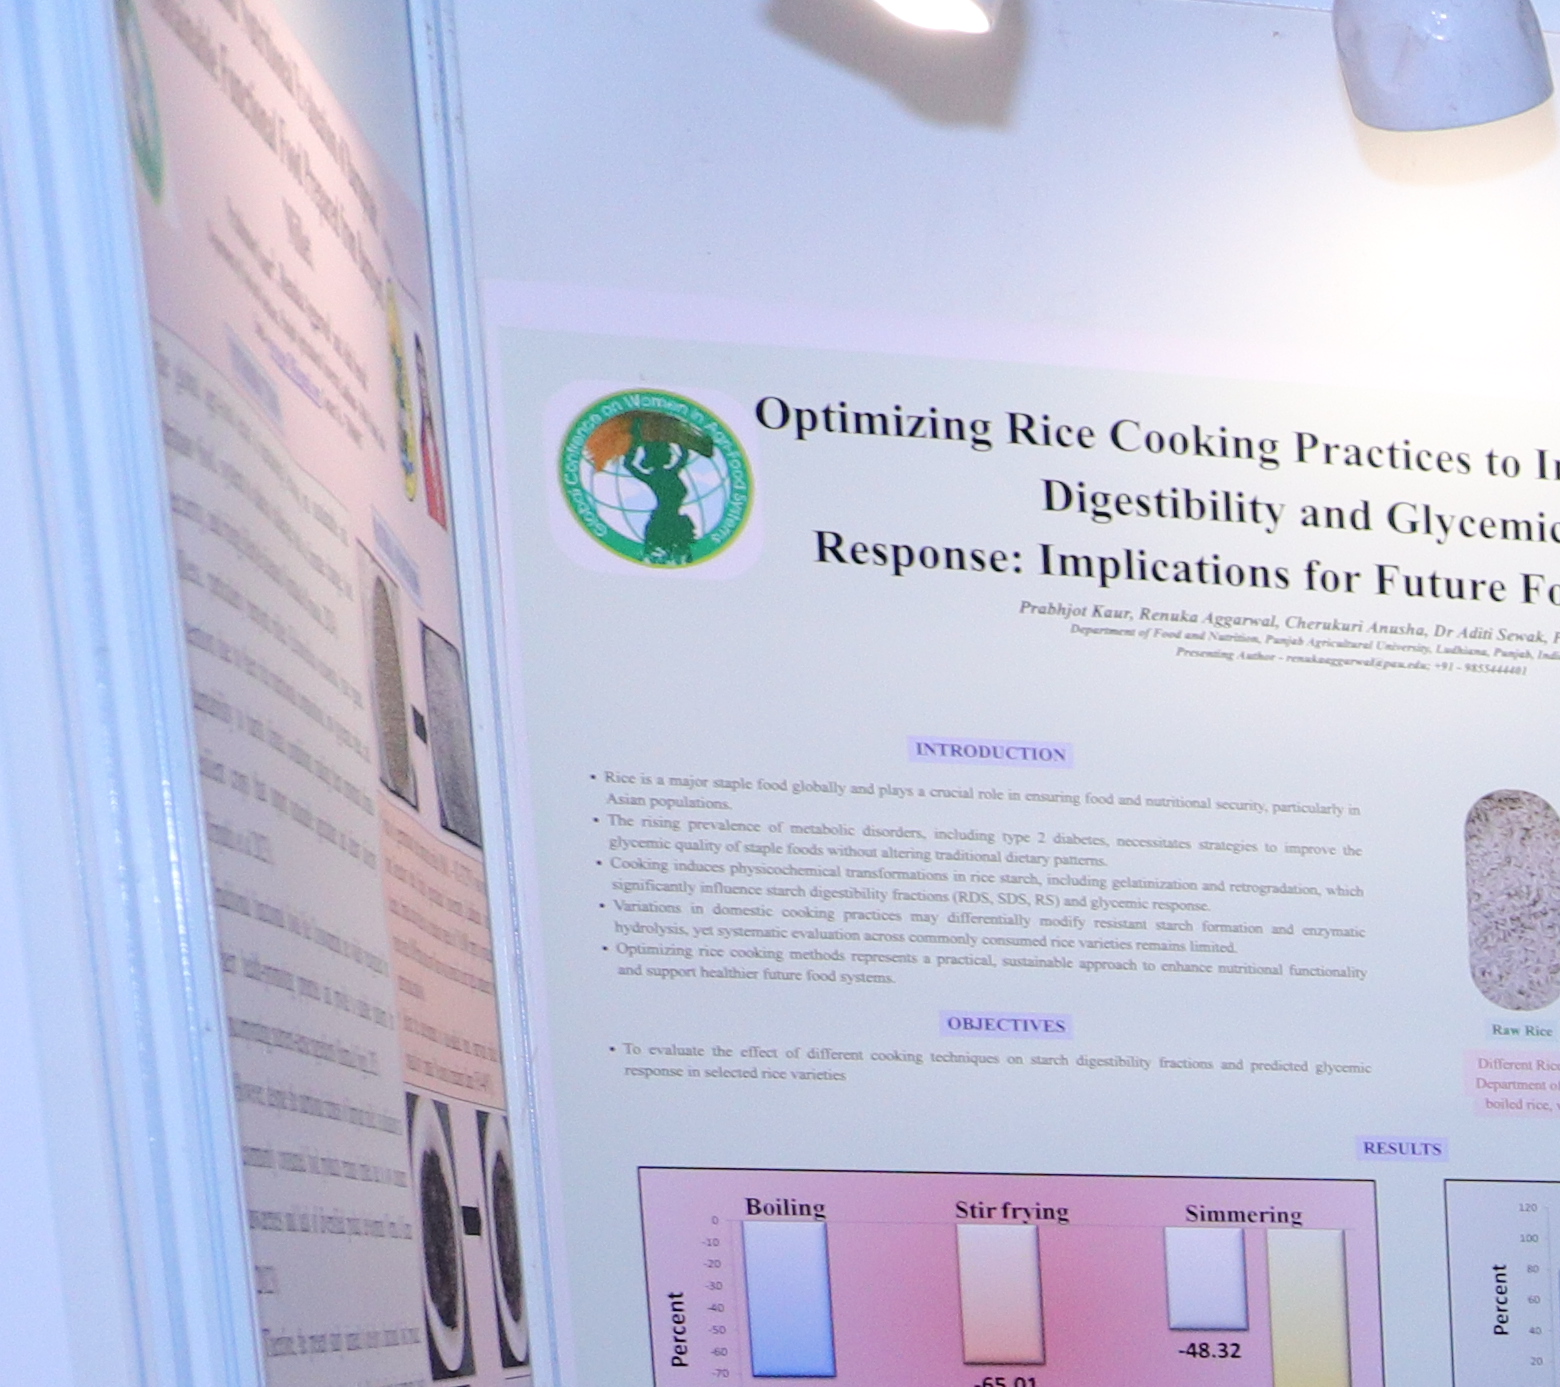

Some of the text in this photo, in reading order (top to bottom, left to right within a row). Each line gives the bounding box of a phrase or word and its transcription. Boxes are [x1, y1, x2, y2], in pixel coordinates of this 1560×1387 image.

[755, 396, 993, 452] Optimizing
[1008, 412, 1095, 449] Rice
[1110, 419, 1280, 470] Cooking
[1295, 431, 1471, 475] Practices
[1486, 450, 1521, 478] to
[1041, 479, 1285, 534] Digestibility
[1301, 500, 1372, 531] and
[814, 530, 1022, 577] Response:
[1039, 543, 1290, 589] Implications
[1304, 559, 1361, 593] for
[1376, 564, 1506, 603] Future
[1018, 600, 1088, 620] Prabhjot
[1091, 604, 1134, 621] Kaur,
[1138, 607, 1199, 624] Renuka
[1201, 611, 1280, 630] Aggarwal,
[1284, 615, 1364, 633] Cherukuri
[1369, 621, 1429, 638] Anusha,
[1433, 624, 1455, 638] Dr
[1456, 626, 1493, 640] Aditi
[1496, 627, 1548, 645] Sewak,
[916, 742, 1065, 762] INTRODUCTION
[947, 1016, 1066, 1033] OBJECTIVES
[1363, 1141, 1442, 1156] RESULTS
[745, 1197, 826, 1226] Boiling
[955, 1200, 1070, 1226] Stir frying
[1185, 1204, 1303, 1228] Simmering
[671, 1291, 687, 1368] Percent
[1178, 1342, 1242, 1359] -48.32
